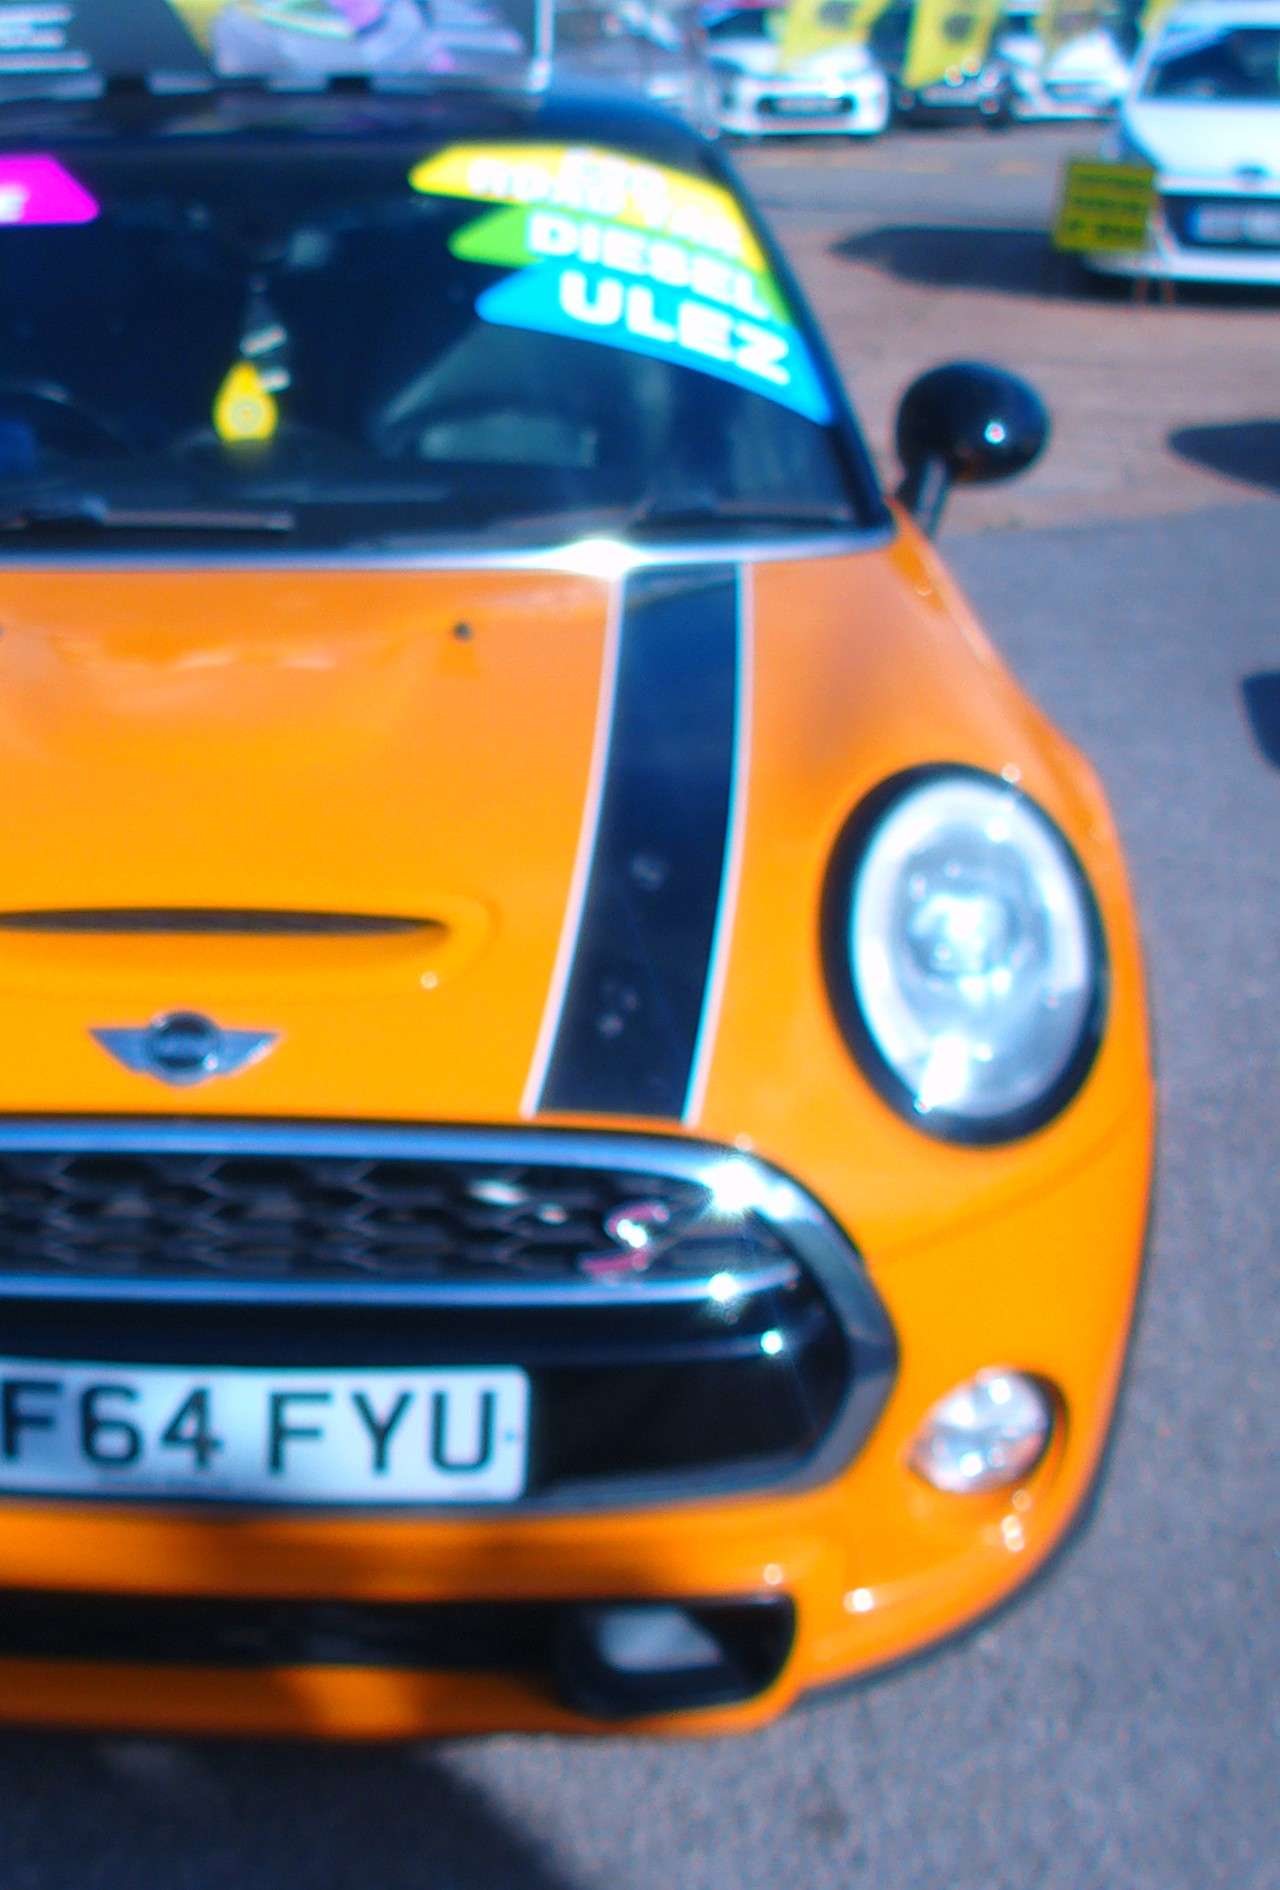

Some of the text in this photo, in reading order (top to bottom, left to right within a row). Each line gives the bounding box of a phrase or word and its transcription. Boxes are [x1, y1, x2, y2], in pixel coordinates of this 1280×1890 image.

[526, 211, 771, 320] DIESEL
[558, 269, 790, 386] ULEZ
[267, 1388, 496, 1477] FYU
